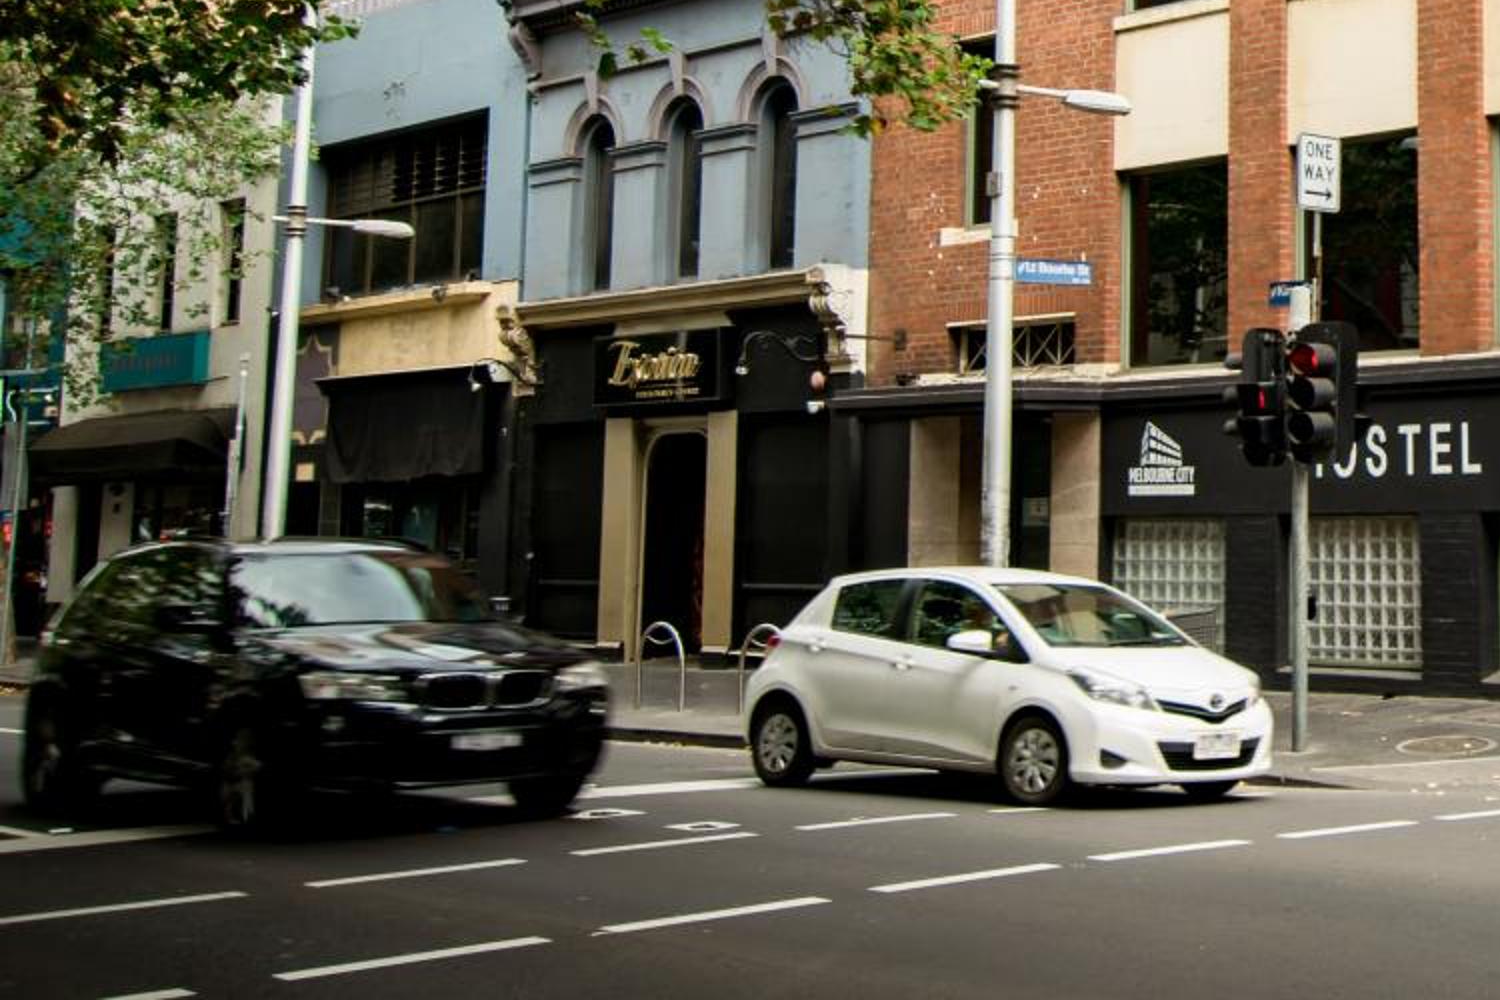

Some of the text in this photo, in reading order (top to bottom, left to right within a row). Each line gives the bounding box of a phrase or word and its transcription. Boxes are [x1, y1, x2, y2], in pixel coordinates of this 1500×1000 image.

[1305, 141, 1333, 160] ONE
[1304, 163, 1335, 183] WAY
[1315, 421, 1482, 479] STEL
[1128, 465, 1195, 483] MELBOURNE CITY
